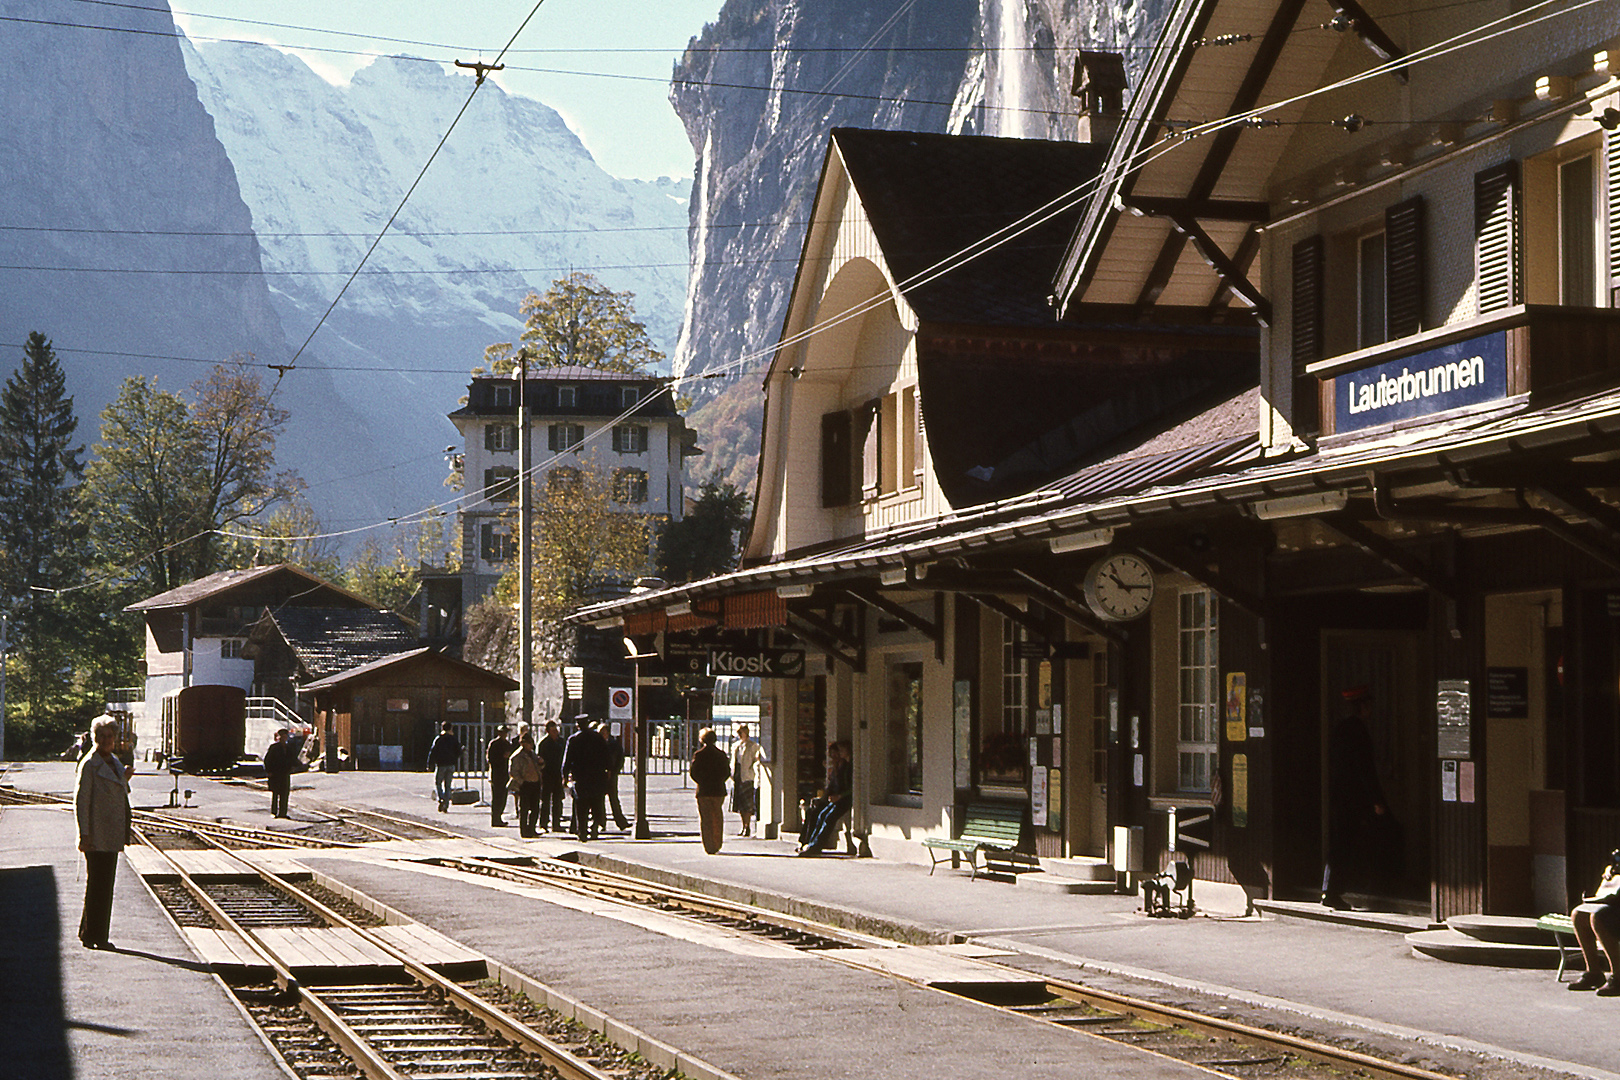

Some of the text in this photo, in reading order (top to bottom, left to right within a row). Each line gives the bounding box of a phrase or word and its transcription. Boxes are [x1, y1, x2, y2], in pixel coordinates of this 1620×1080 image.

[1349, 355, 1485, 415] Lauterbrunnen
[690, 658, 699, 670] 6
[711, 650, 773, 673] Kiosk
